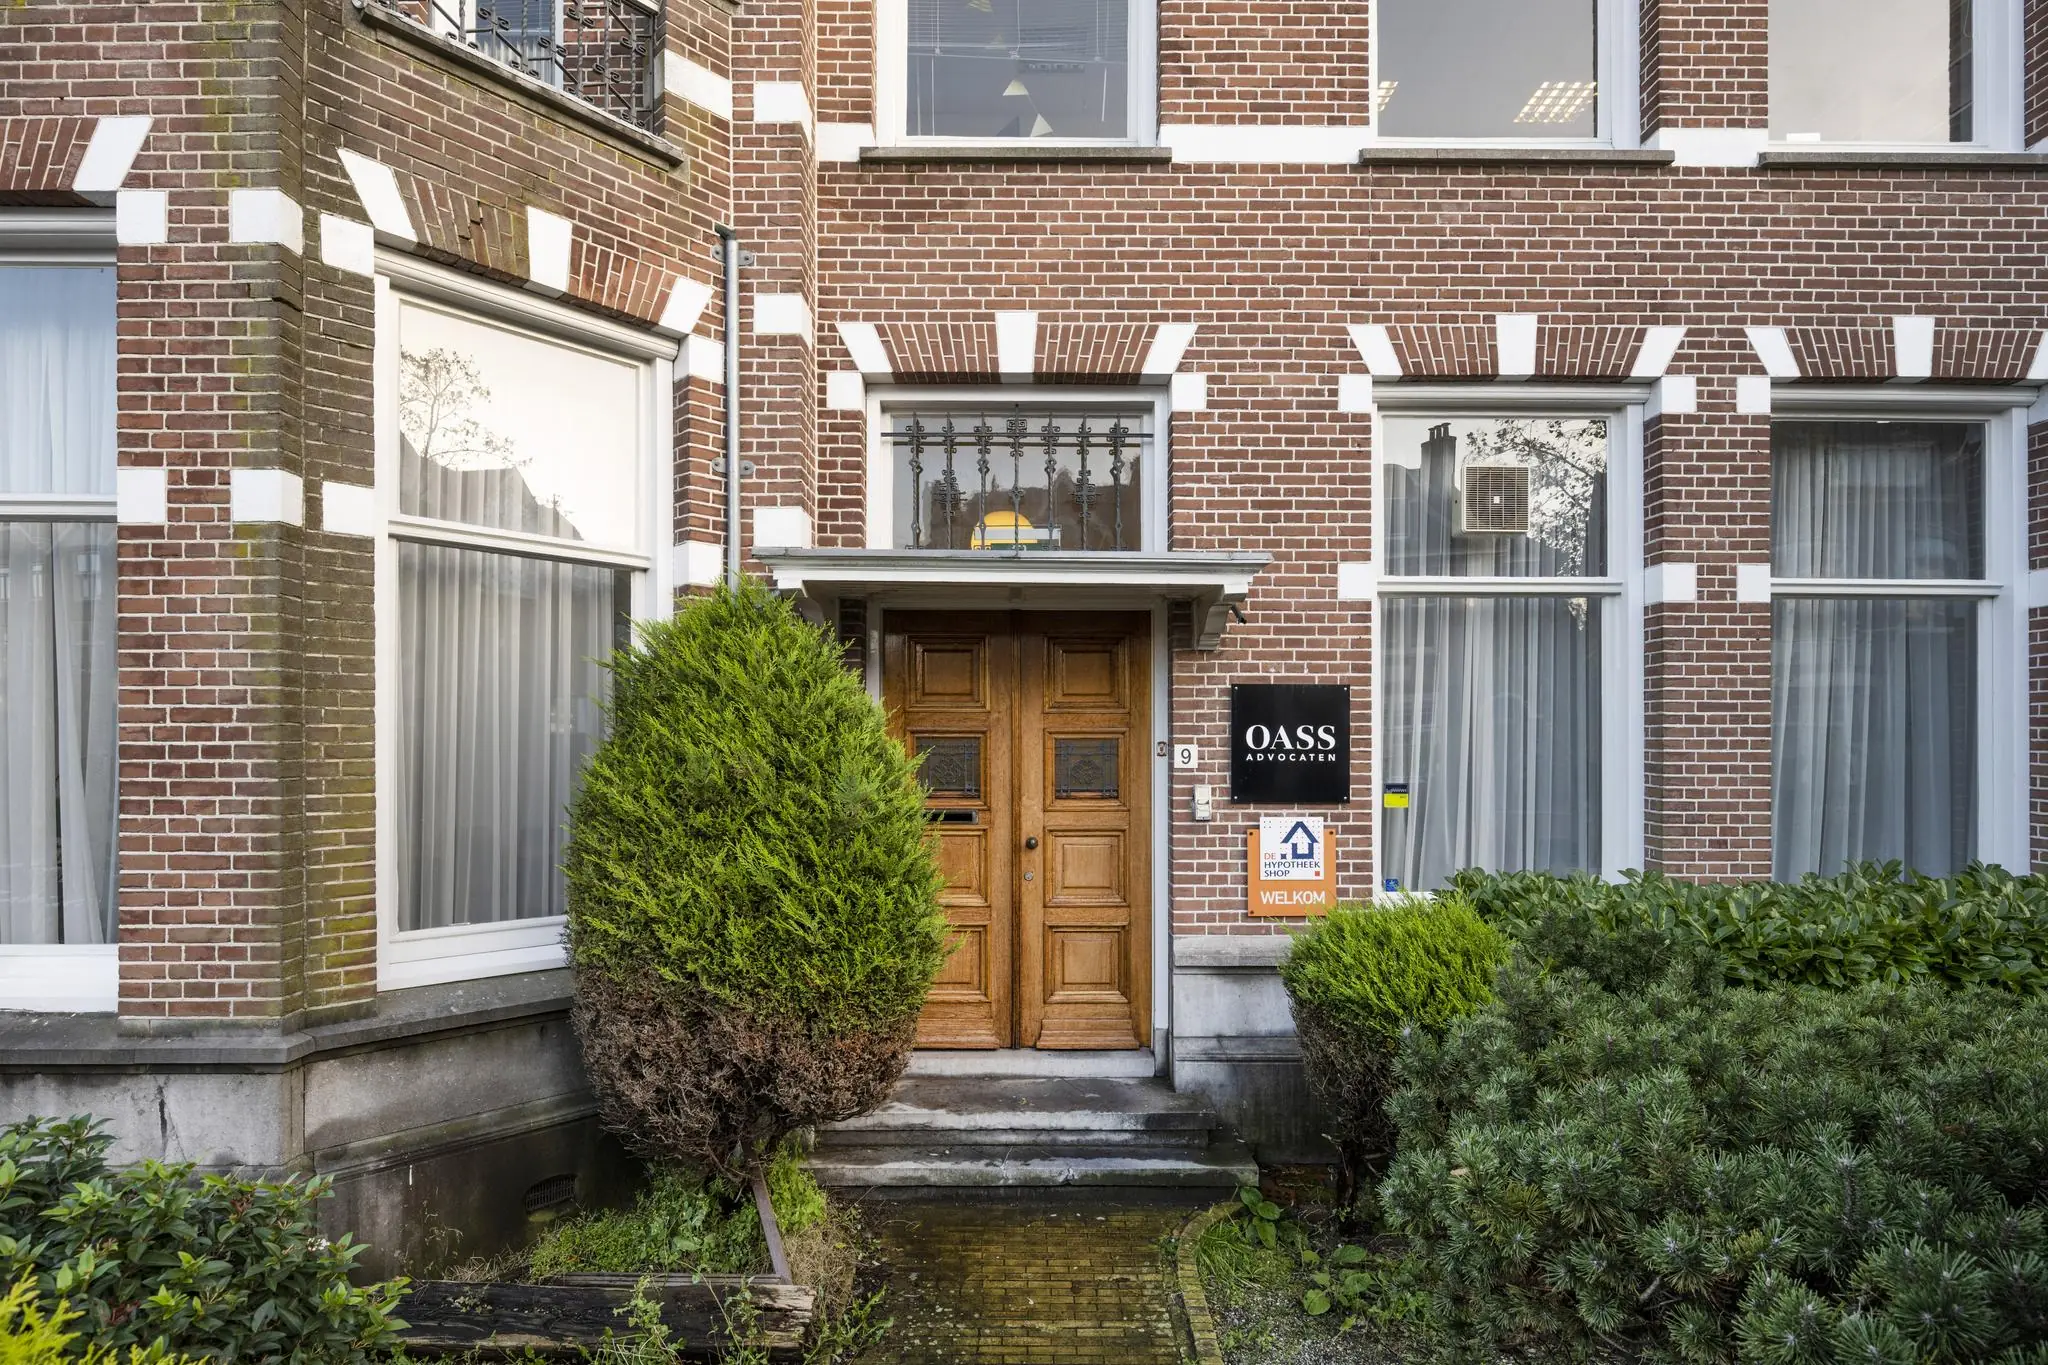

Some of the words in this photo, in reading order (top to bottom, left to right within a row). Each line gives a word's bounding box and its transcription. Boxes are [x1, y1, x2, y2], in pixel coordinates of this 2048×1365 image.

[1245, 724, 1336, 750] OASS
[1181, 748, 1192, 765] 9
[1245, 753, 1336, 761] ADVOCATEN
[1264, 852, 1276, 860] DE
[1264, 869, 1290, 877] SHOP
[1260, 890, 1326, 905] WELKOM
